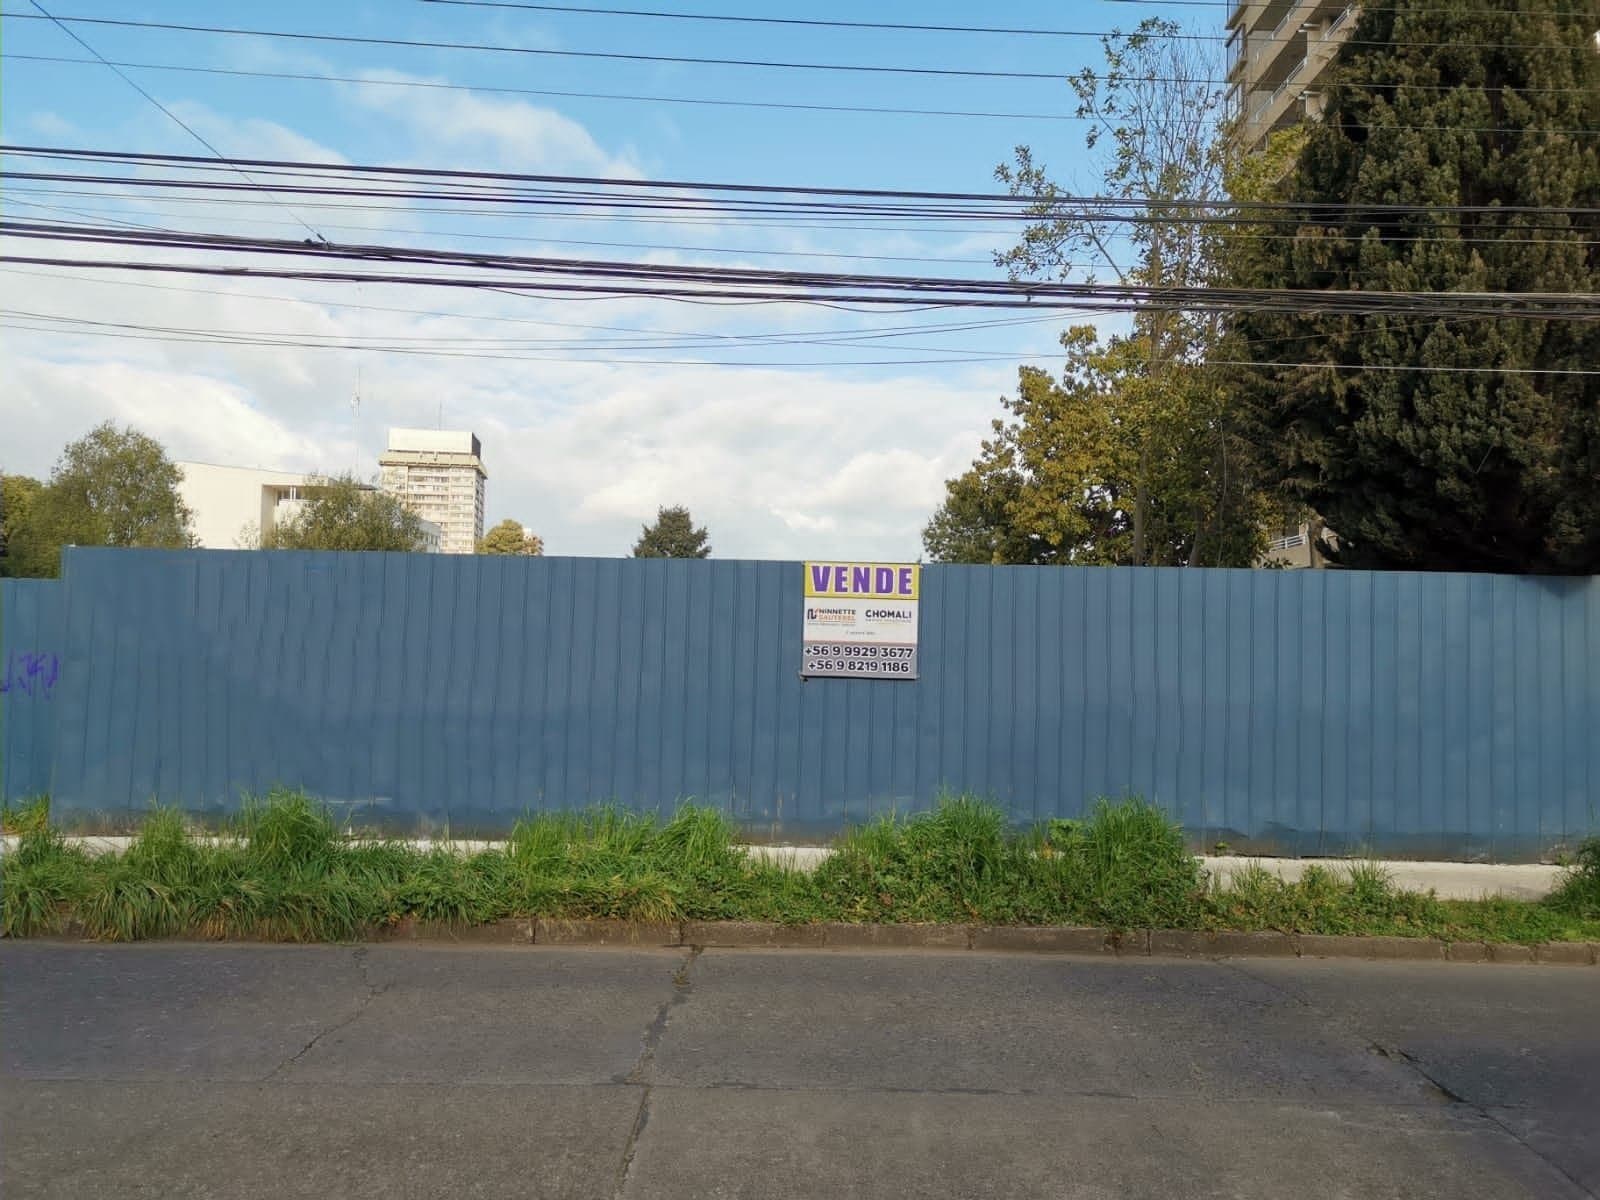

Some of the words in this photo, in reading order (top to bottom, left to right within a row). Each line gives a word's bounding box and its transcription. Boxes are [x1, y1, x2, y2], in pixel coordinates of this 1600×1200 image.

[811, 565, 913, 595] VENDE
[865, 609, 912, 619] CHOMALI
[805, 646, 829, 656] +56
[832, 646, 841, 656] 9
[844, 647, 877, 657] 9929
[881, 648, 913, 658] 3677
[808, 660, 833, 670] +56
[836, 661, 845, 670] 9
[848, 661, 878, 671] 8219
[881, 662, 909, 672] 1186
